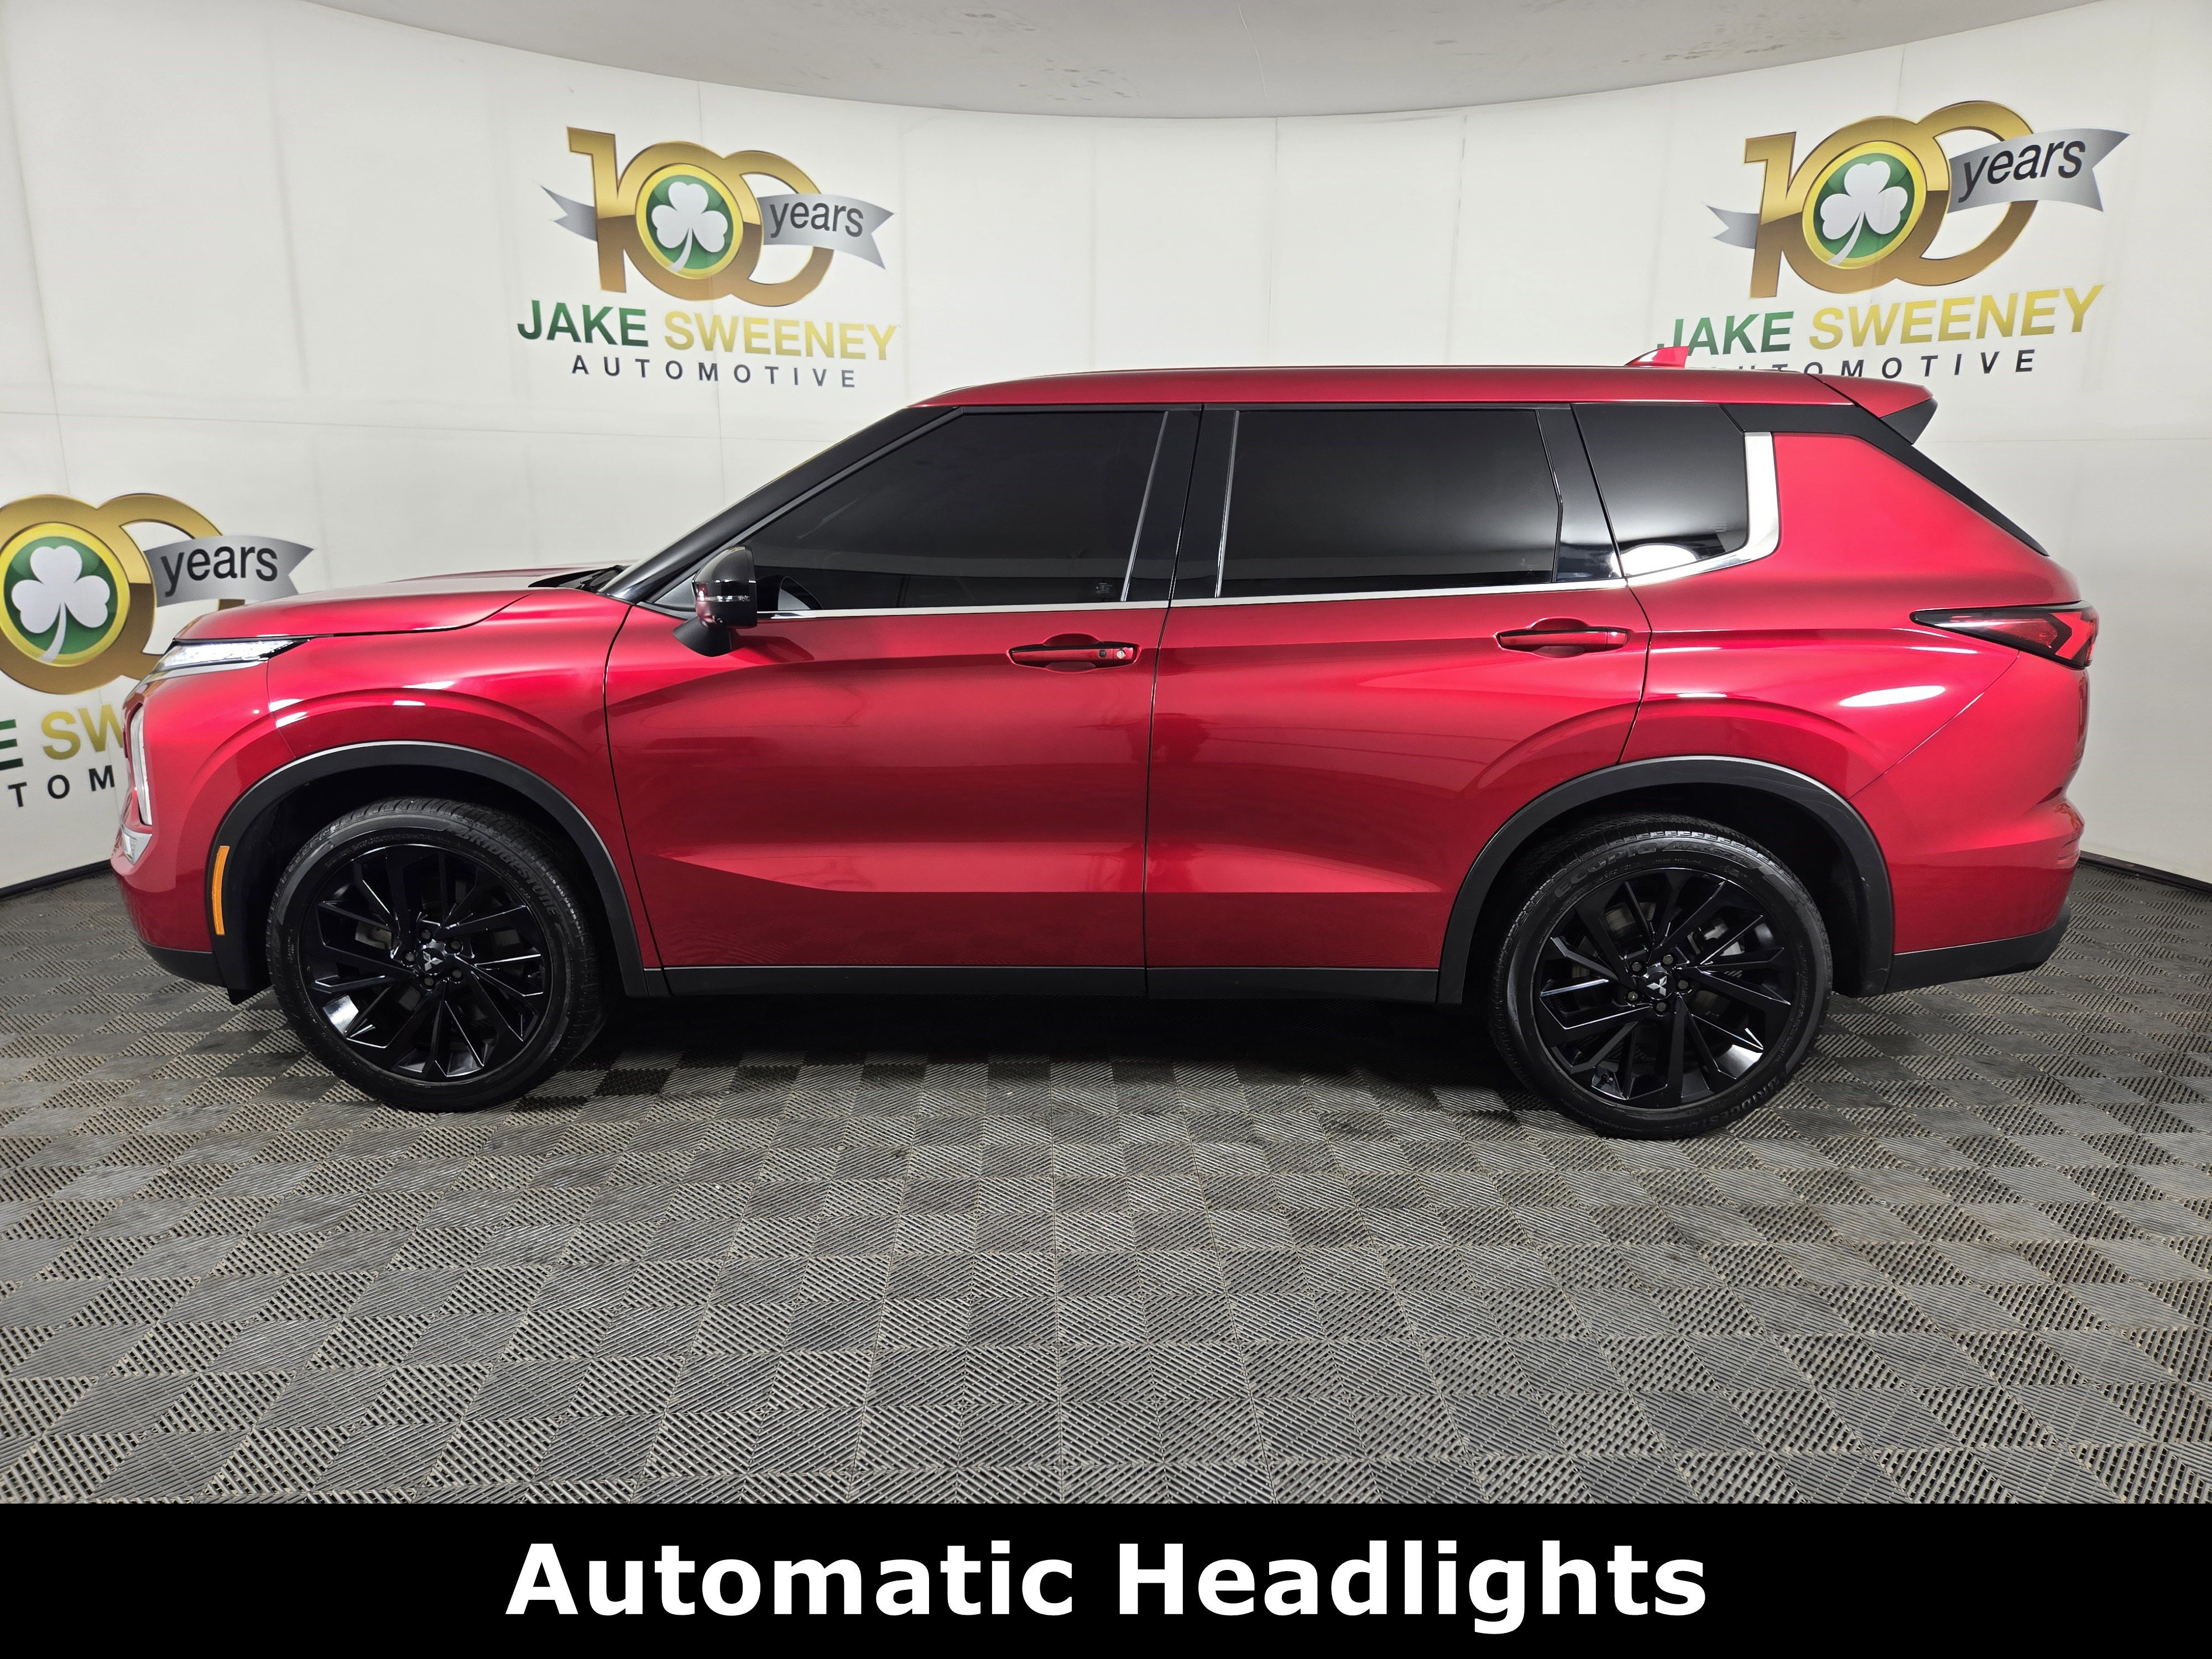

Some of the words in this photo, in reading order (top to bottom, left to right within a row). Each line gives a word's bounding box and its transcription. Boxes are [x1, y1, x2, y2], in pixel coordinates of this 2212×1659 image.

[1744, 100, 2039, 299] 100
[1958, 140, 2086, 204] years
[567, 126, 834, 307] 100
[769, 202, 864, 237] years
[517, 300, 649, 347] JAKE
[664, 311, 897, 361] SWEENEY
[1657, 311, 1794, 356] JAKE
[1809, 284, 2104, 350] SWEENEY
[572, 355, 855, 388] AUTOMOTIVE
[161, 546, 278, 596] years
[455, 824, 560, 916] BRIDGESTONE
